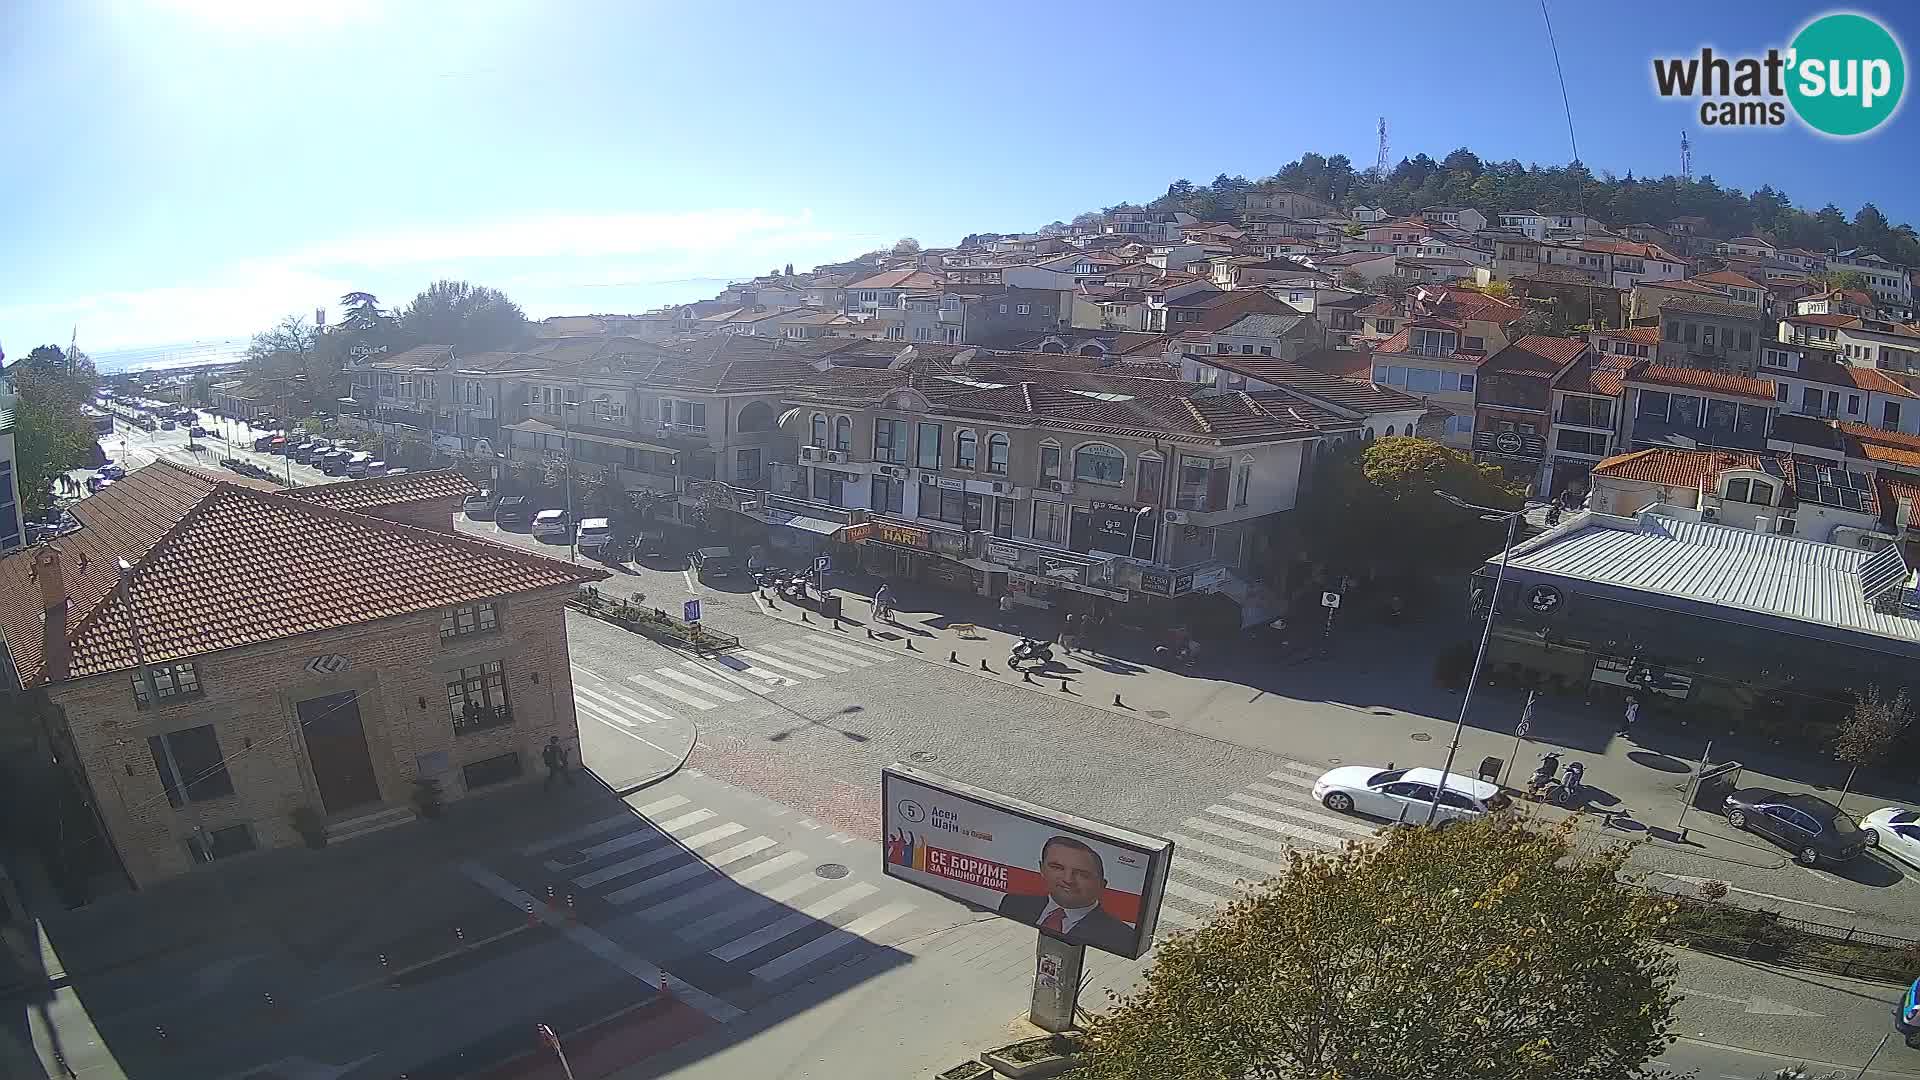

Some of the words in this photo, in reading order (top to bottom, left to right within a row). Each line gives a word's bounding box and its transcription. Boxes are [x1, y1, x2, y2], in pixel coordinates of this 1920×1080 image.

[883, 529, 916, 546] HARI
[819, 559, 826, 570] P
[908, 805, 916, 818] 5
[931, 806, 958, 821] Асен
[931, 817, 959, 833] Шајн
[930, 851, 947, 866] СЕ
[951, 855, 1009, 881] БОРИМЕ
[930, 863, 942, 873] ЗА
[982, 876, 1008, 891] ДОМ!
